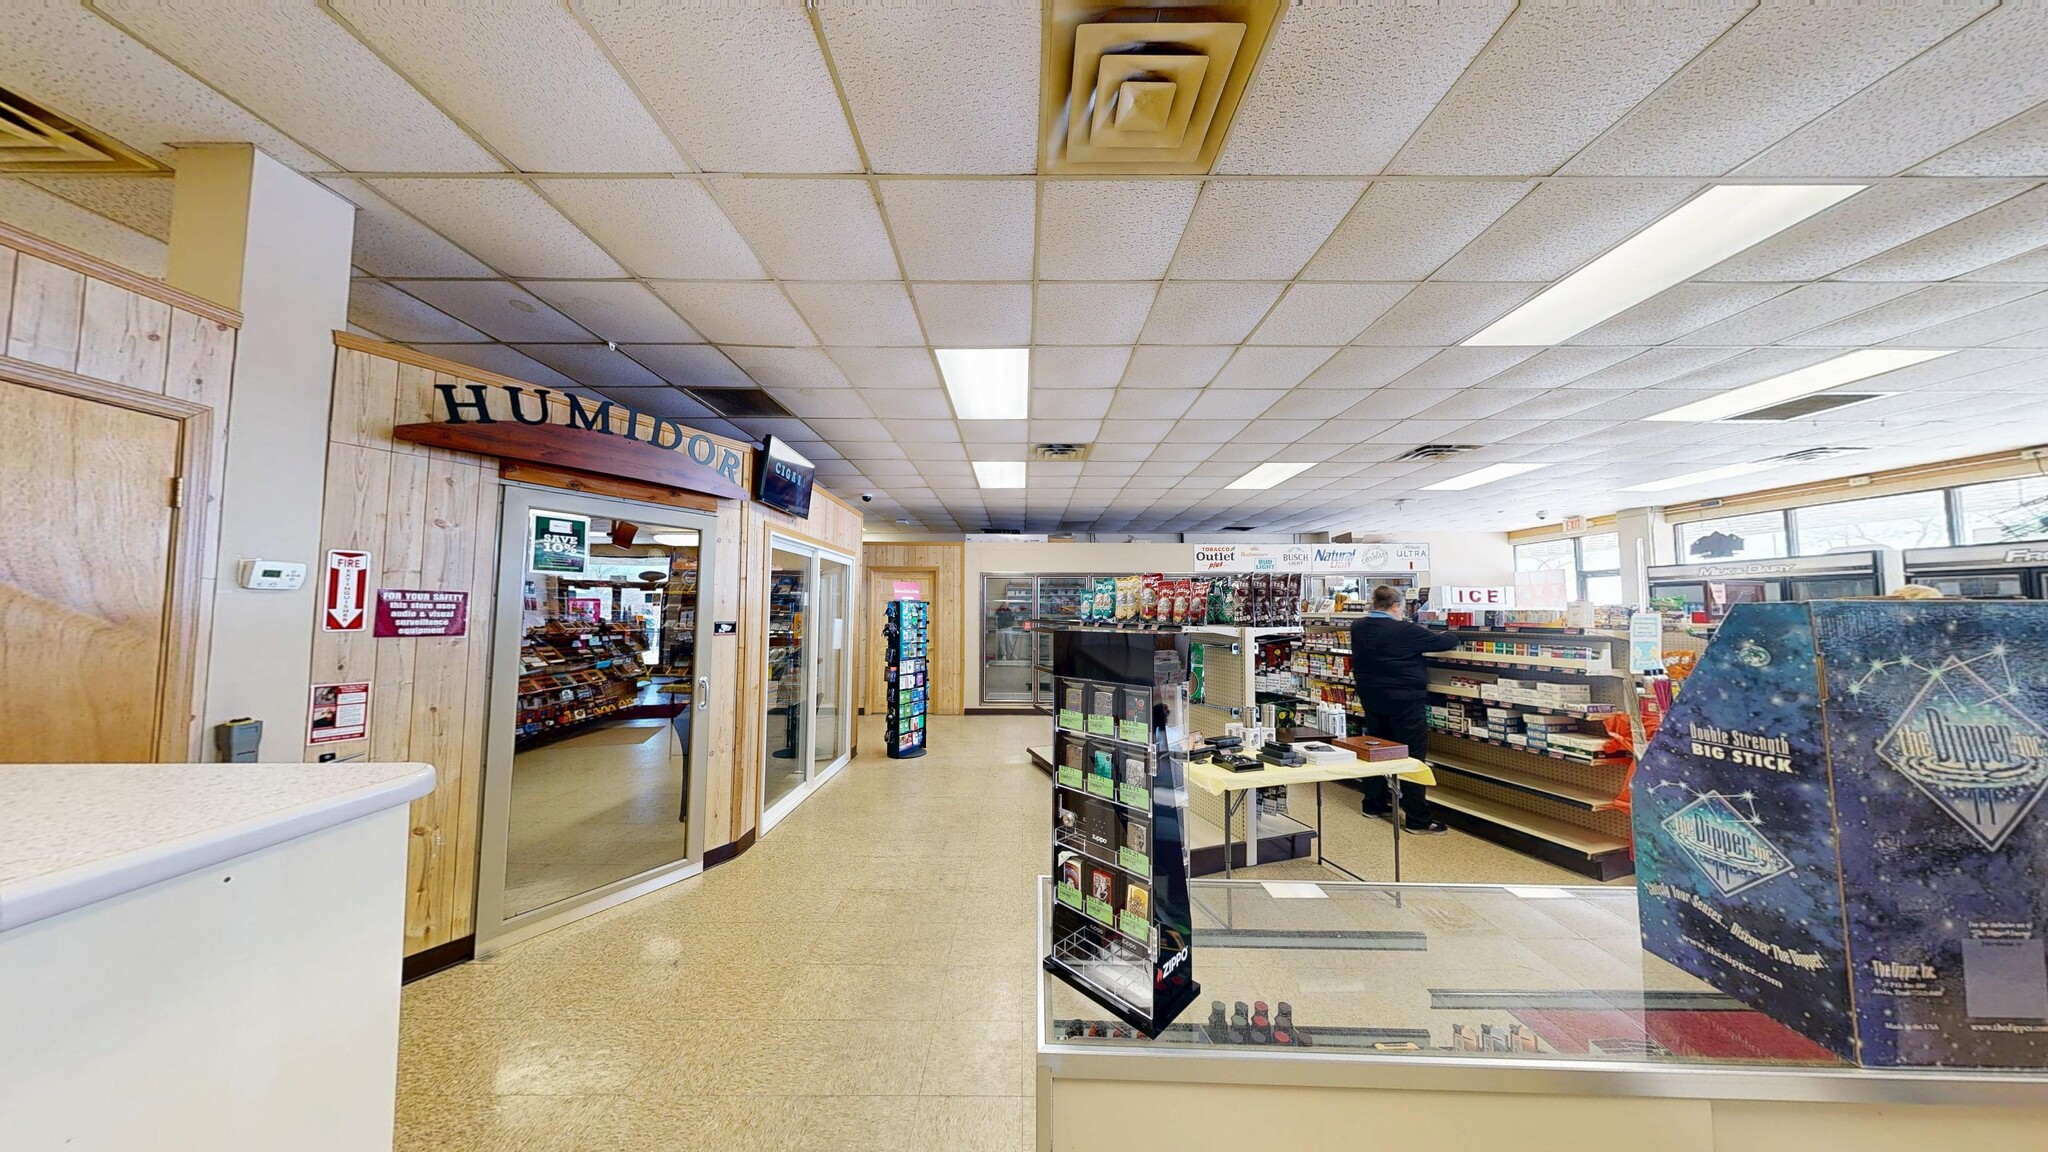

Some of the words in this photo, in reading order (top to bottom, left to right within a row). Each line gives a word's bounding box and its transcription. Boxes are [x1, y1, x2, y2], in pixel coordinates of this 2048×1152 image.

[435, 384, 741, 484] HUMIDOR
[543, 533, 578, 544] SAVE
[543, 543, 577, 554] 10%
[1314, 548, 1356, 562] Natural
[337, 558, 361, 568] FIRE
[1196, 551, 1236, 561] Outlet
[1283, 553, 1309, 561] BUSCH
[383, 592, 402, 600] FOR
[405, 592, 430, 600] YOUR
[433, 593, 464, 601] SAFETY
[1458, 590, 1499, 603] ICE
[428, 610, 454, 618] visual
[397, 627, 445, 635] equipment
[1689, 721, 1729, 744] Double
[1731, 729, 1790, 755] Strength
[1897, 724, 1932, 756] the
[1925, 706, 2013, 771] Dipper
[1691, 742, 1725, 760] BIG
[1731, 750, 1793, 774] STICK
[1675, 816, 1694, 835] the
[1694, 812, 1751, 858] Dipper
[1670, 884, 1691, 903] Your
[1692, 894, 1729, 930] Senses...
[1730, 921, 1771, 955] Discover
[1770, 943, 1792, 965] The
[1162, 946, 1188, 979] ZIPPO
[1680, 933, 1784, 989] www.thedipper.com
[1872, 960, 1891, 978] The
